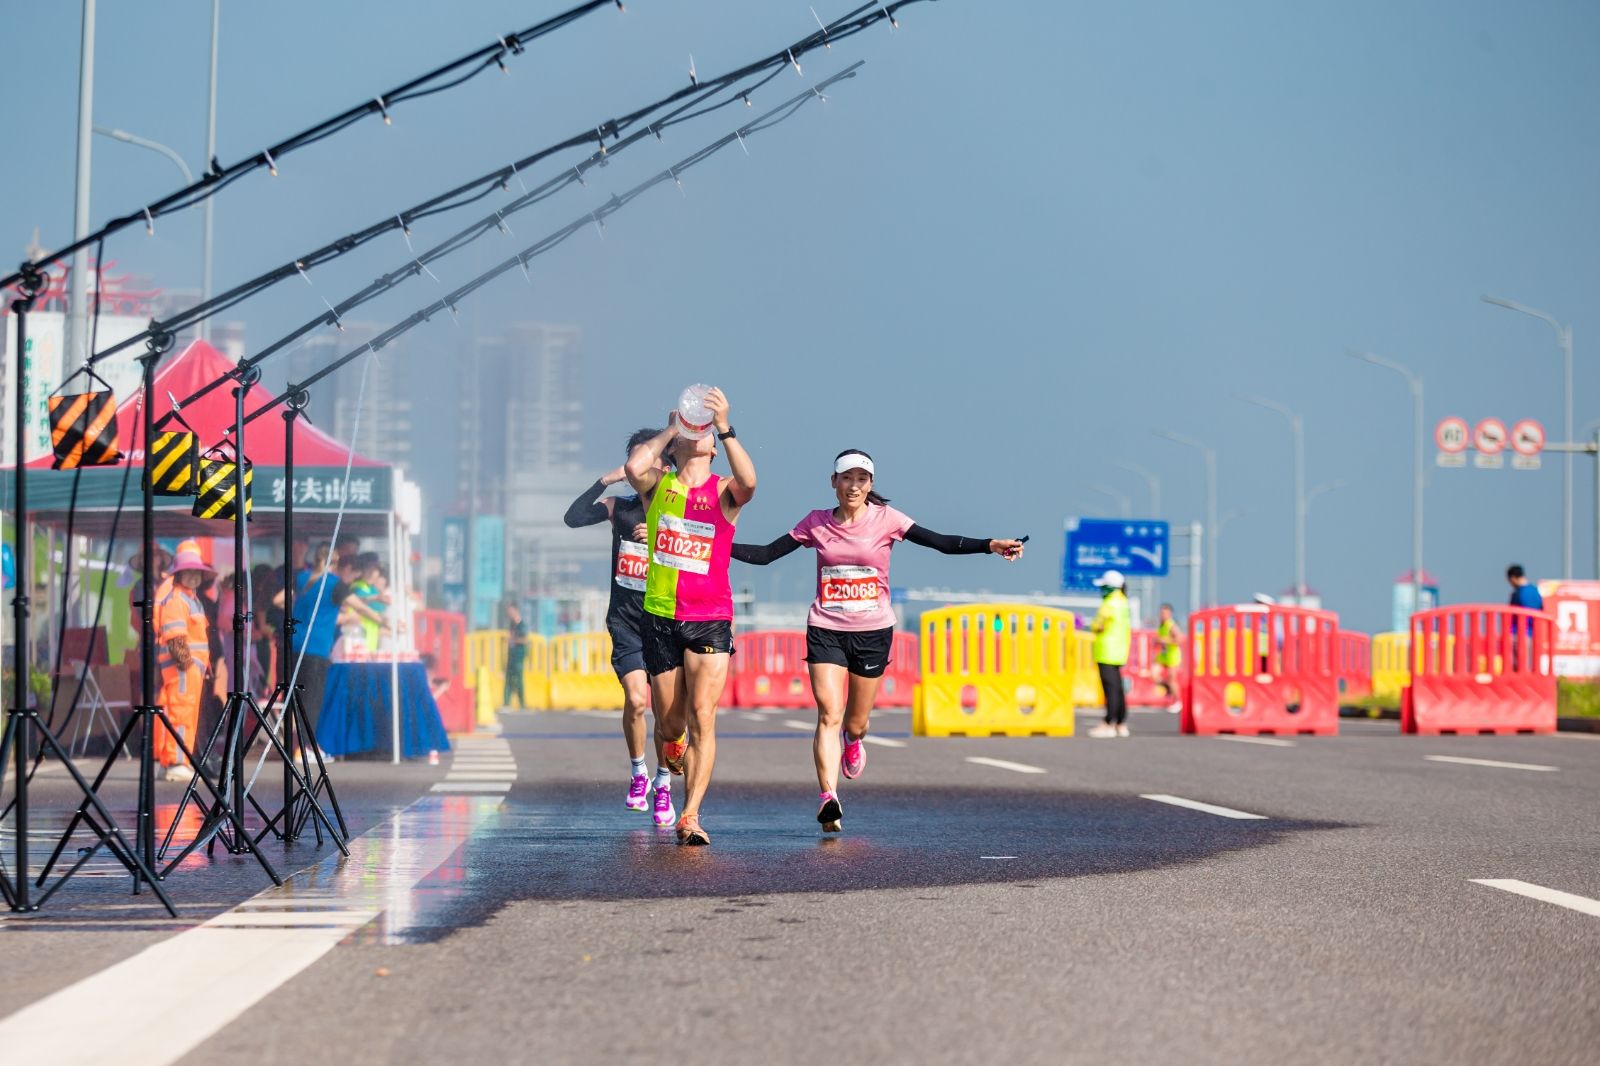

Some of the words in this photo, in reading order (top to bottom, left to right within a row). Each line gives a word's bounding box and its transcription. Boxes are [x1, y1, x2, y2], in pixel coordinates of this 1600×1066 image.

[272, 477, 372, 504] 农夫山泉
[664, 489, 678, 504] 77
[656, 532, 711, 559] C10237
[824, 582, 877, 599] C20068
